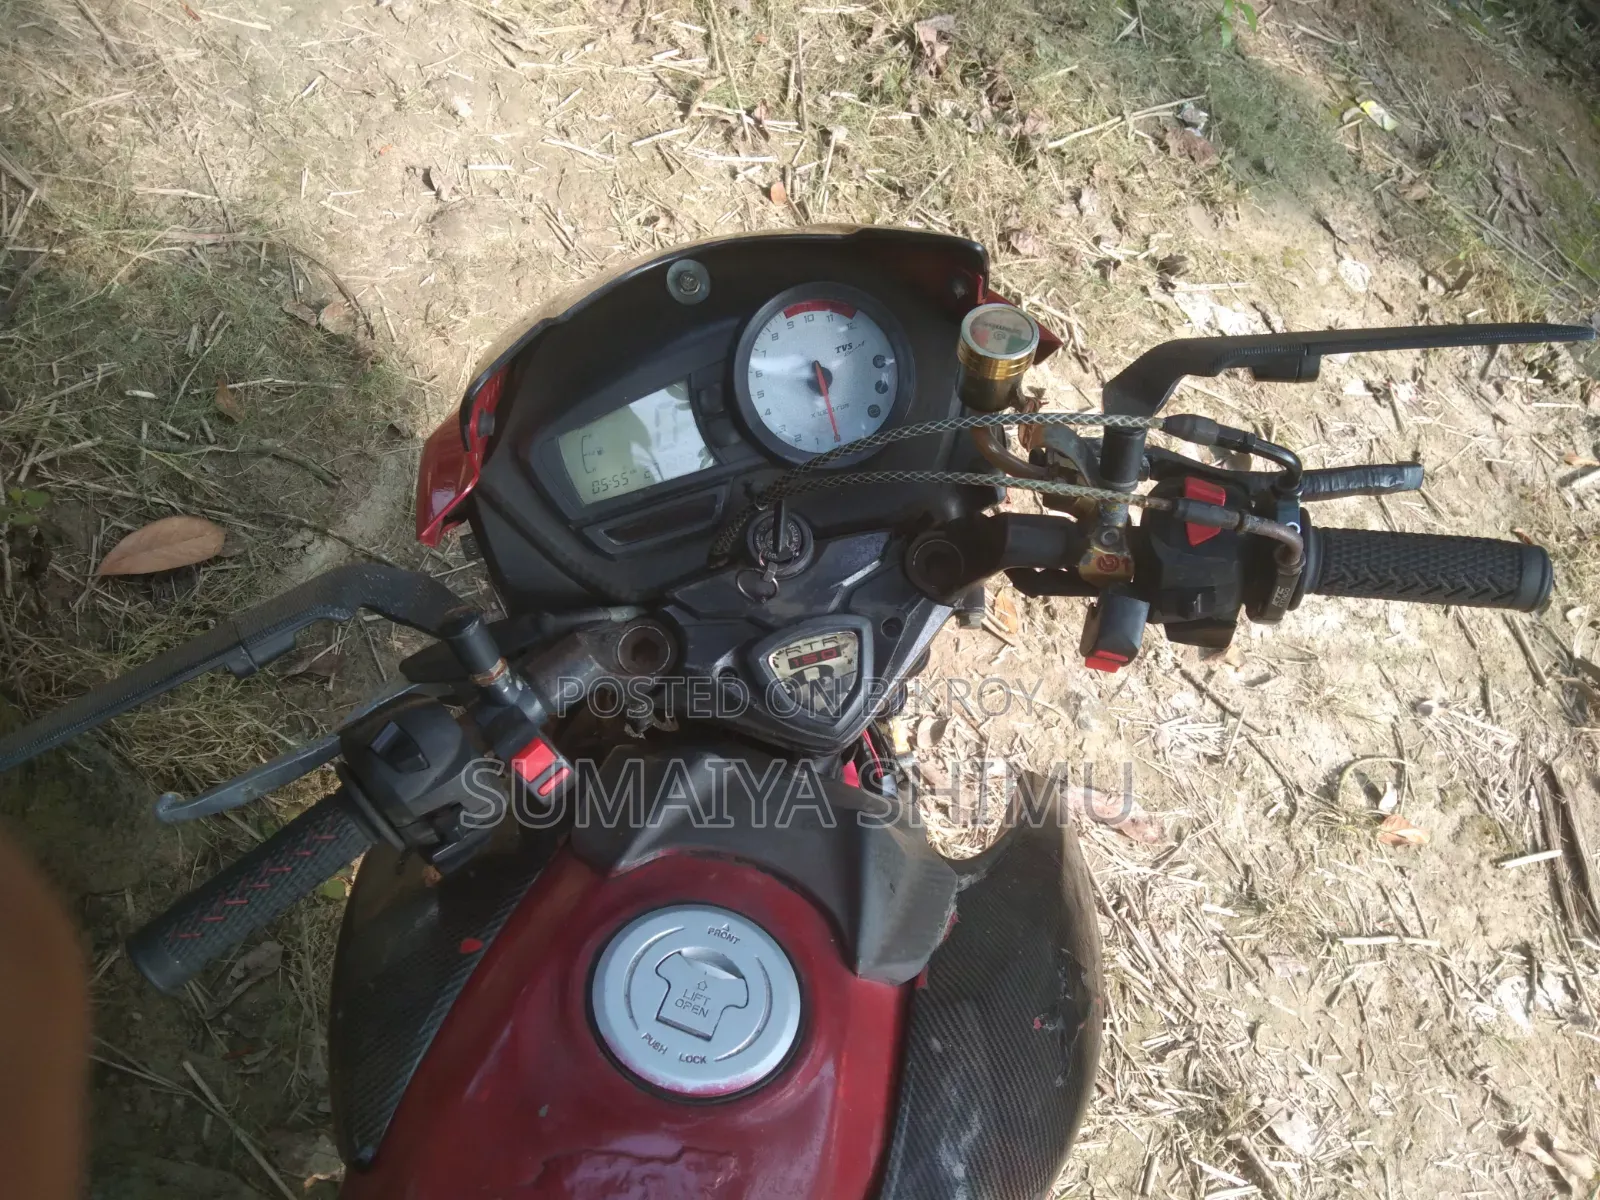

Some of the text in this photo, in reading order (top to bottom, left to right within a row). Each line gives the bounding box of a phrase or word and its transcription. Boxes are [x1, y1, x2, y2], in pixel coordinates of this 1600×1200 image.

[804, 314, 815, 323] 10
[826, 313, 834, 323] 11
[786, 321, 795, 330] 9
[771, 332, 779, 341] 8
[834, 342, 853, 354] TVS
[762, 350, 768, 358] 7
[755, 370, 763, 378] 6
[757, 391, 765, 399] 5
[764, 408, 772, 416] 4
[794, 435, 802, 443] 2
[815, 437, 819, 445] 1
[592, 472, 629, 494] 05:55
[785, 636, 839, 656] RTR
[792, 649, 838, 667] 150
[707, 925, 741, 945] FRONT
[683, 988, 712, 1006] LIFT
[674, 999, 709, 1018] OPEN
[641, 1032, 668, 1054] PUSH
[679, 1052, 707, 1064] LOCK
